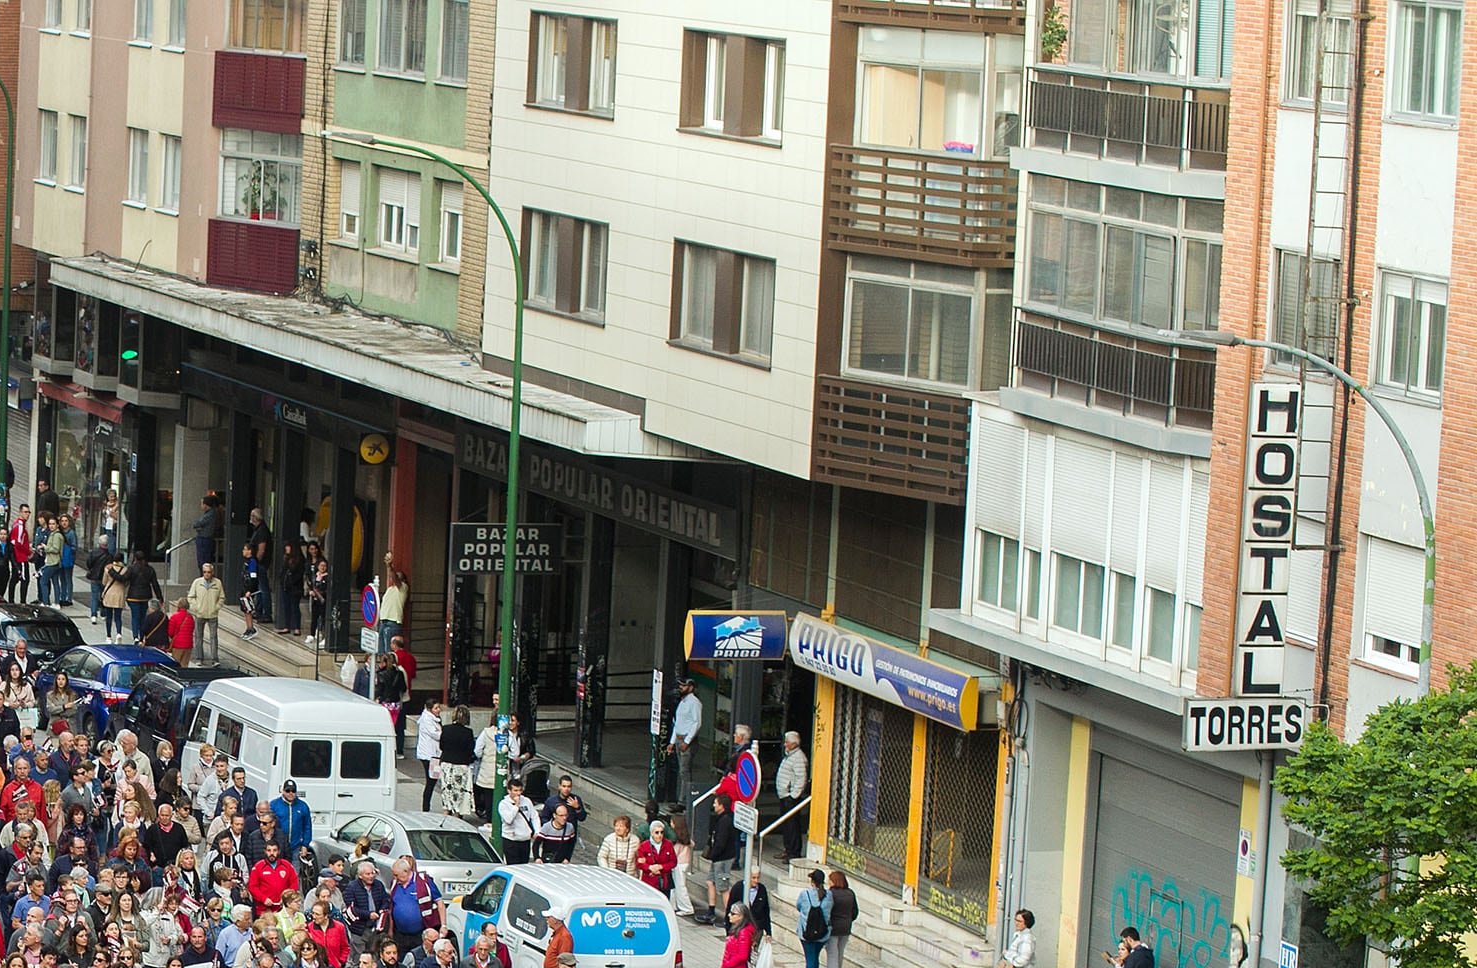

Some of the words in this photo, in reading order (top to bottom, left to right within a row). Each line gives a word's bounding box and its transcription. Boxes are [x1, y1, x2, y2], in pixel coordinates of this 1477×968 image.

[463, 434, 509, 475] BAZA
[529, 455, 614, 511] POPULAR
[621, 484, 722, 547] ORIENTAL
[1240, 389, 1301, 695] HOSTAL
[713, 649, 761, 658] PRIGO
[799, 623, 867, 677] PRIGO
[1189, 704, 1302, 747] TORRES
